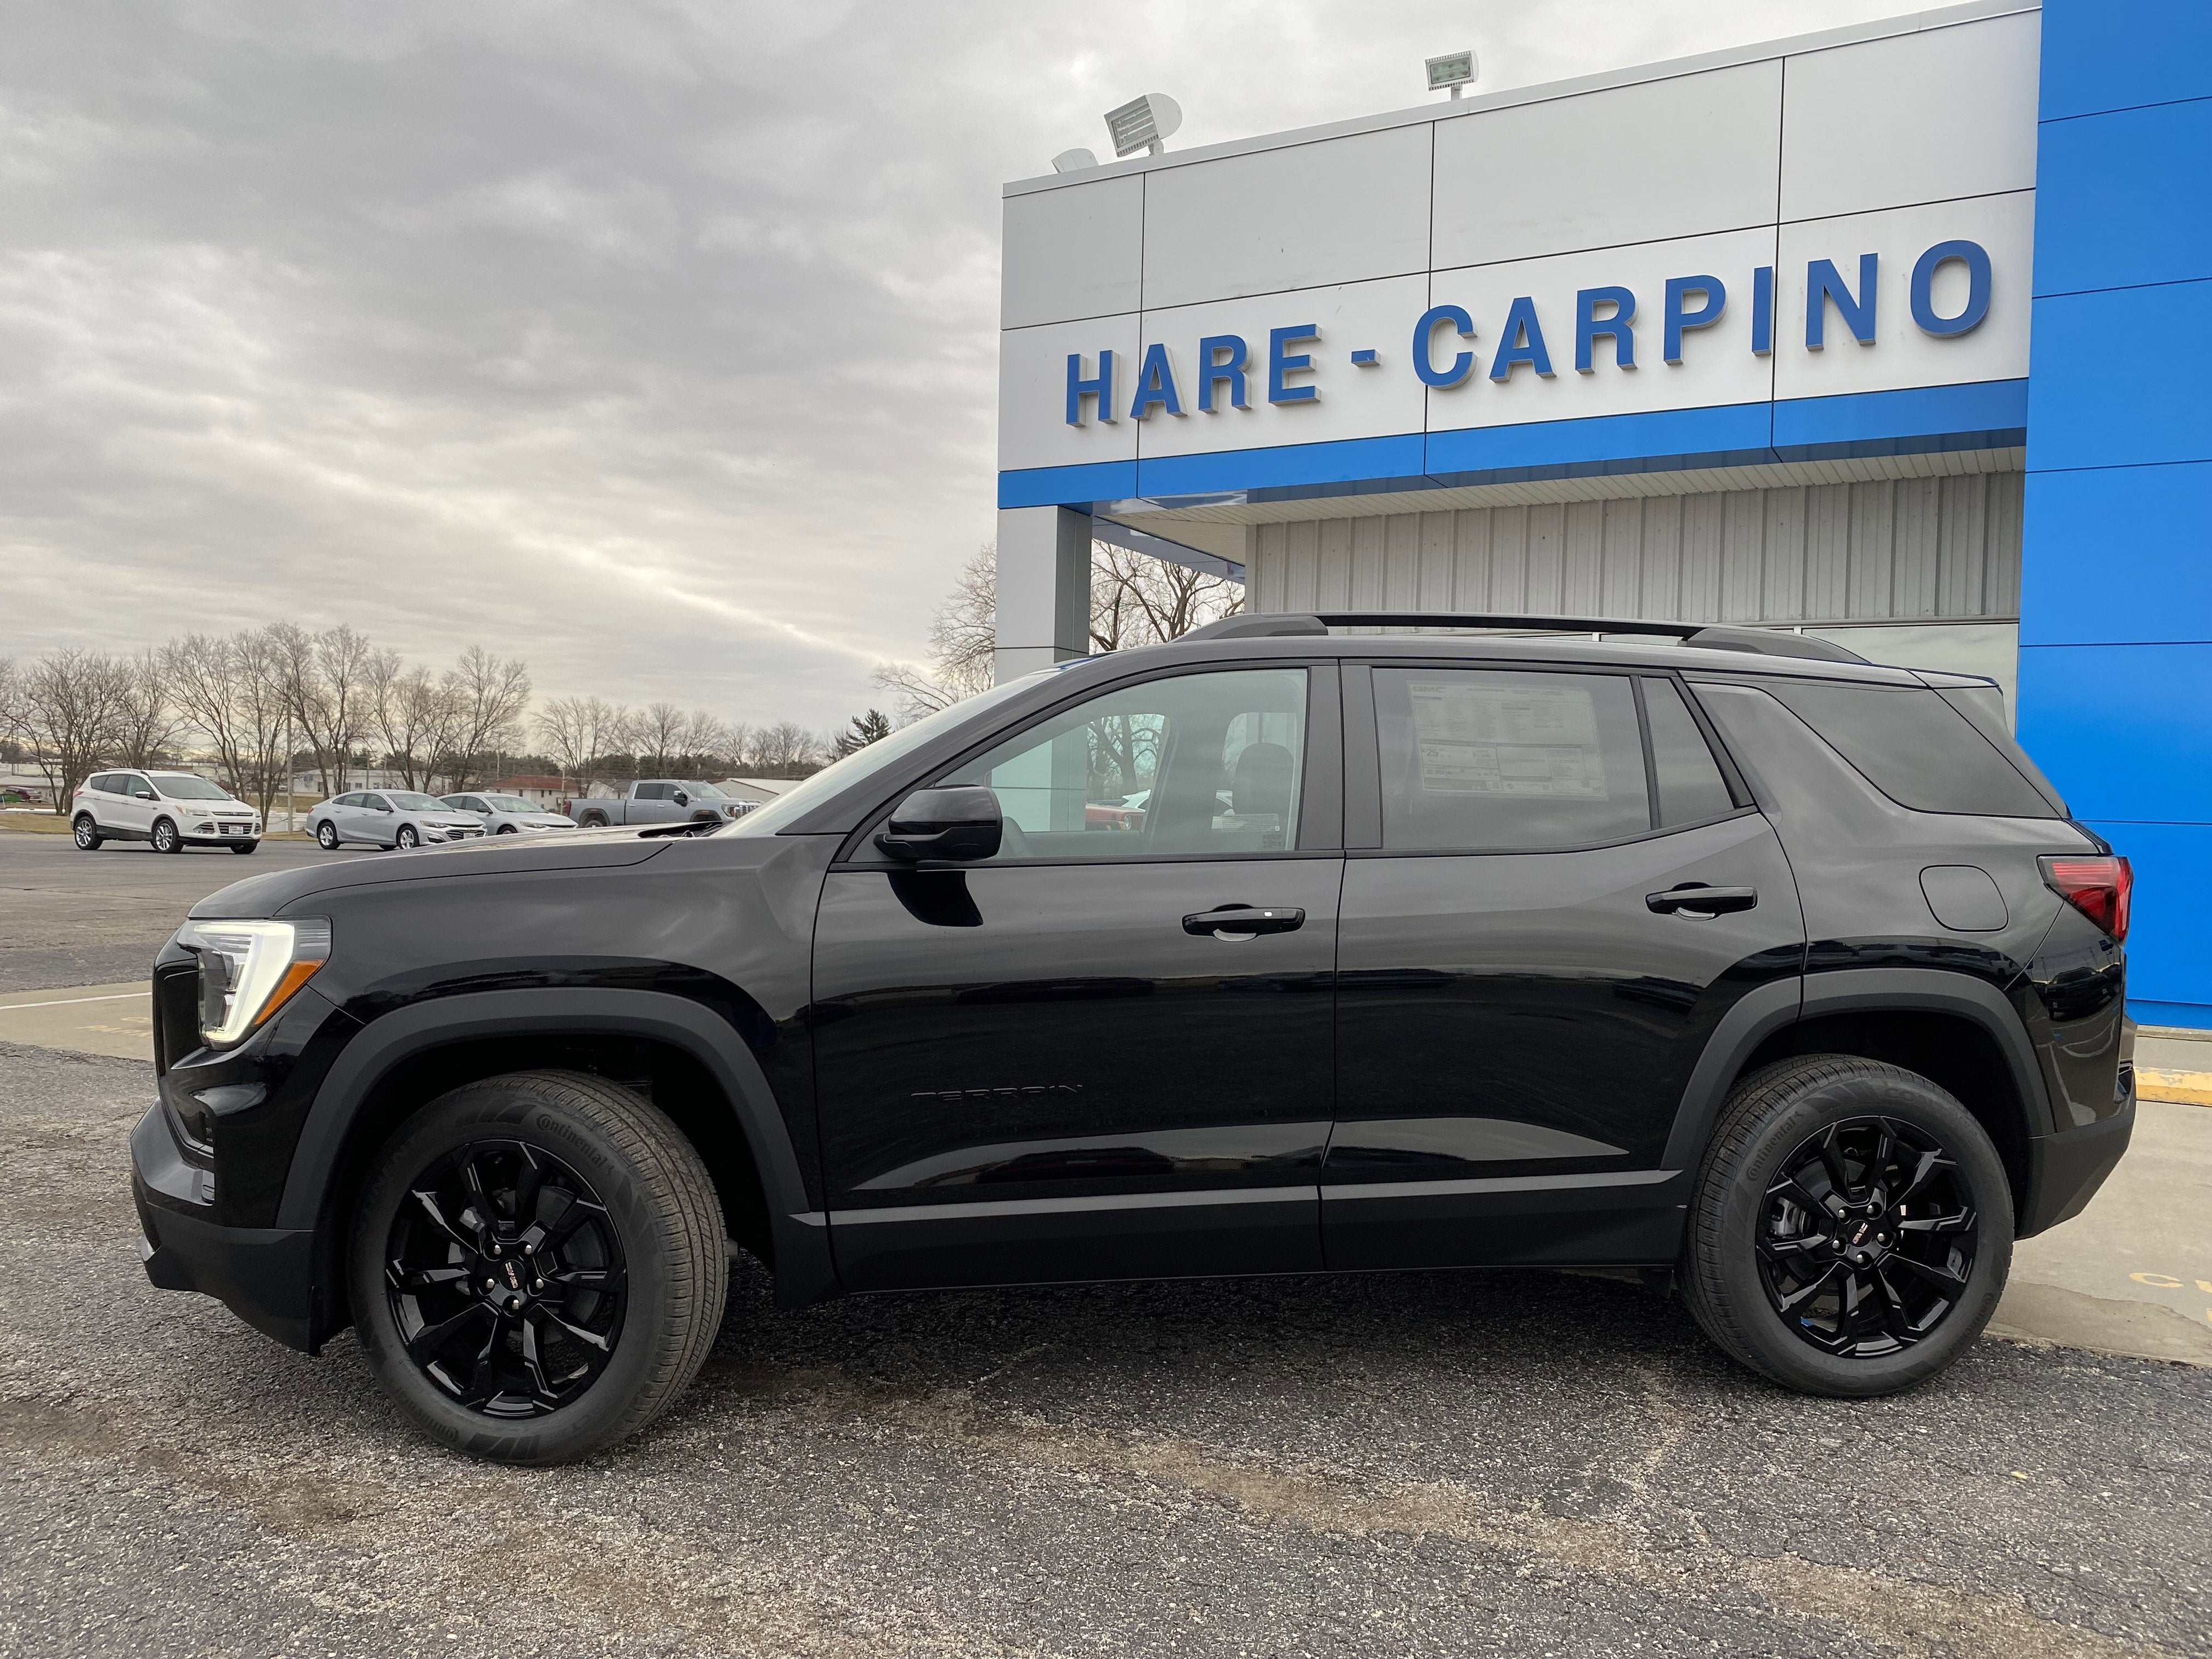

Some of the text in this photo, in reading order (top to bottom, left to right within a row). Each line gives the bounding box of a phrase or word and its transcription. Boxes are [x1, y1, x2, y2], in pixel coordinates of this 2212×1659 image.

[1066, 324, 1320, 427] HARE
[1412, 239, 1992, 388] CARPINO
[1426, 748, 1439, 757] 25
[536, 1114, 608, 1167] Continental
[1746, 1116, 1797, 1182] Continental
[1852, 1222, 1868, 1244] GMC
[505, 1261, 518, 1289] GMC
